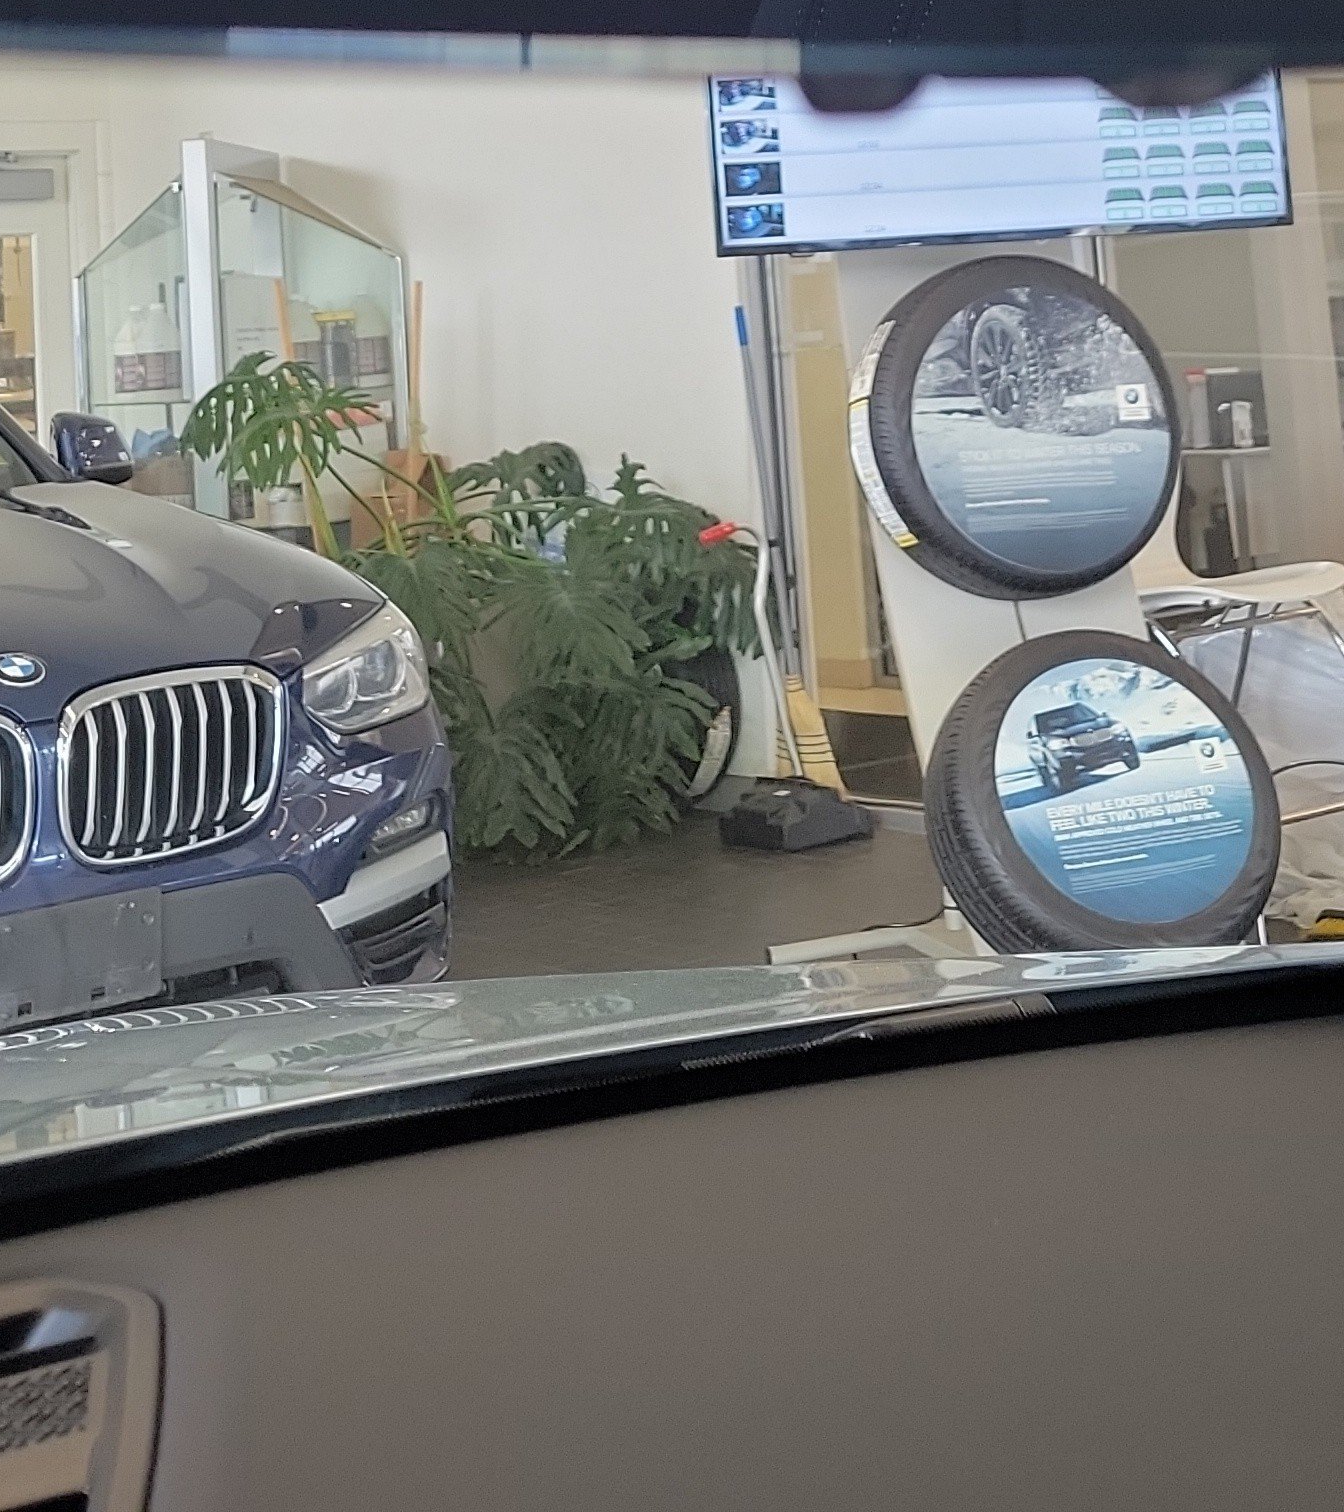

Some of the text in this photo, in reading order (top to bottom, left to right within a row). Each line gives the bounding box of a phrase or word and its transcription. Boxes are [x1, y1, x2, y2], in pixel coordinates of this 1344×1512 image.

[1046, 804, 1083, 819] EVERY
[1086, 800, 1112, 813] MILE
[1165, 789, 1197, 802] HAVE
[1198, 785, 1215, 797] TO
[1049, 799, 1213, 831] FEEL LIKE TWO THIS WINTER.
